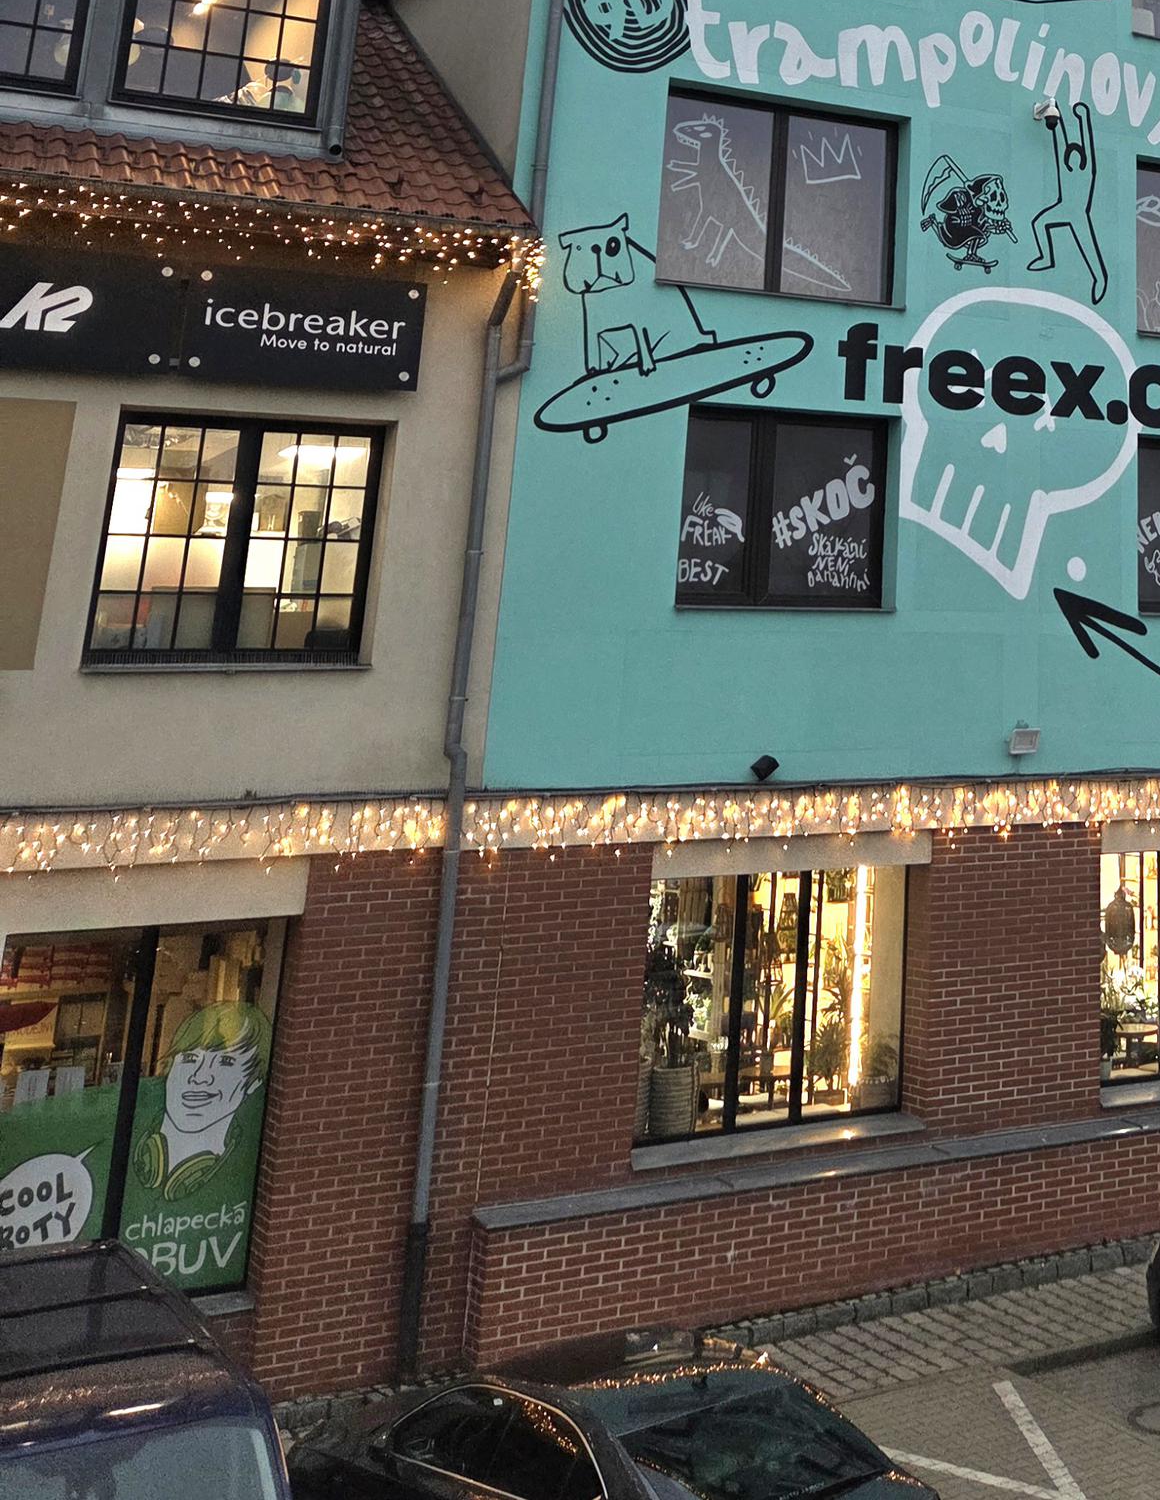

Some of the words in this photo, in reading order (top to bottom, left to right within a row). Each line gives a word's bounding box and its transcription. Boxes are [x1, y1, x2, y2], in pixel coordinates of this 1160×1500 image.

[0, 282, 94, 332] K2
[204, 298, 406, 340] icebreaker
[260, 333, 307, 351] Move
[314, 338, 330, 352] to
[336, 341, 397, 356] natural
[678, 558, 729, 586] BEST
[125, 1200, 248, 1241] chlapecká
